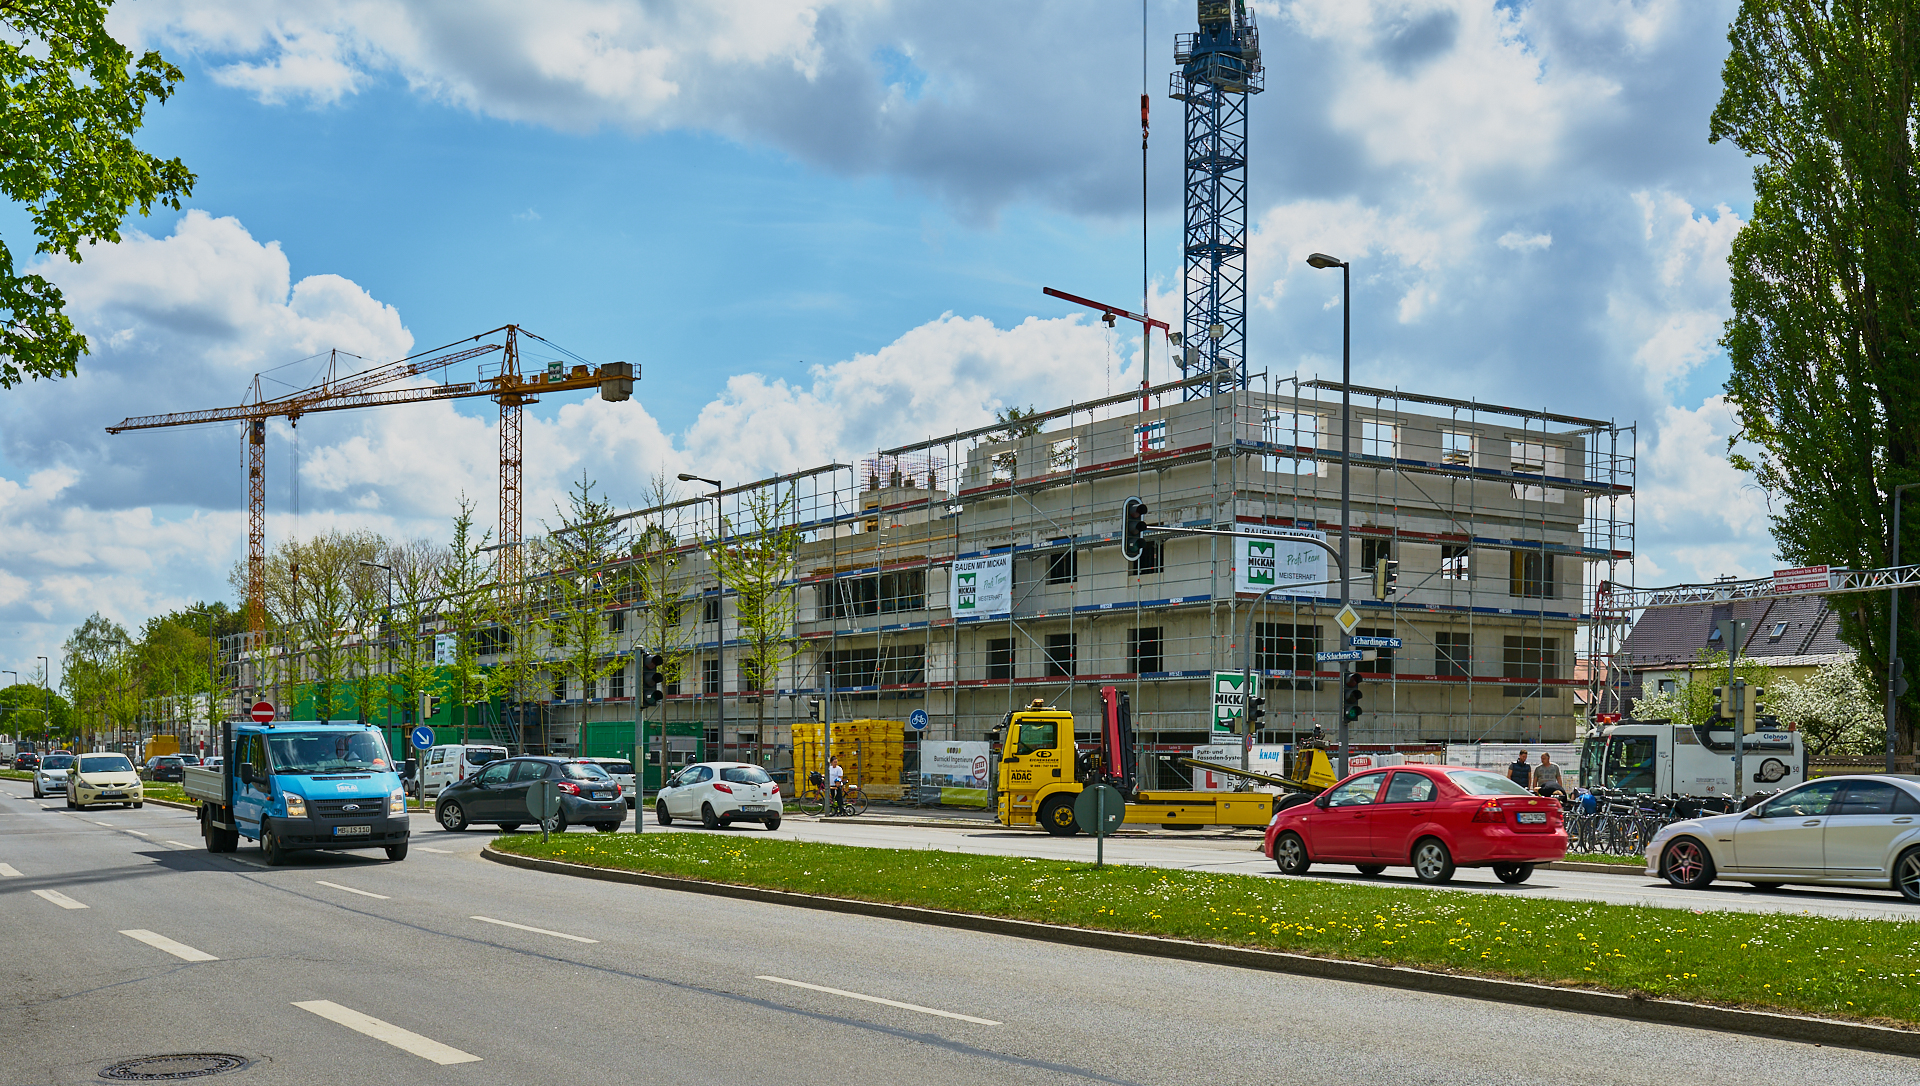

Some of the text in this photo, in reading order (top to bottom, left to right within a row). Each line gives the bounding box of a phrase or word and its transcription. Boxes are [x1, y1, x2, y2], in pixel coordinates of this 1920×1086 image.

[1304, 550, 1320, 562] Team
[955, 558, 1006, 571] BAUEN MIT MICKAN
[1248, 558, 1275, 567] MICKAN
[1279, 572, 1316, 580] MEISTERHAFT
[1353, 637, 1388, 647] Echardinger
[1317, 651, 1360, 660] Bad-Schachener-Str.
[951, 756, 973, 764] Ingenieure
[975, 761, 984, 769] JETZT
